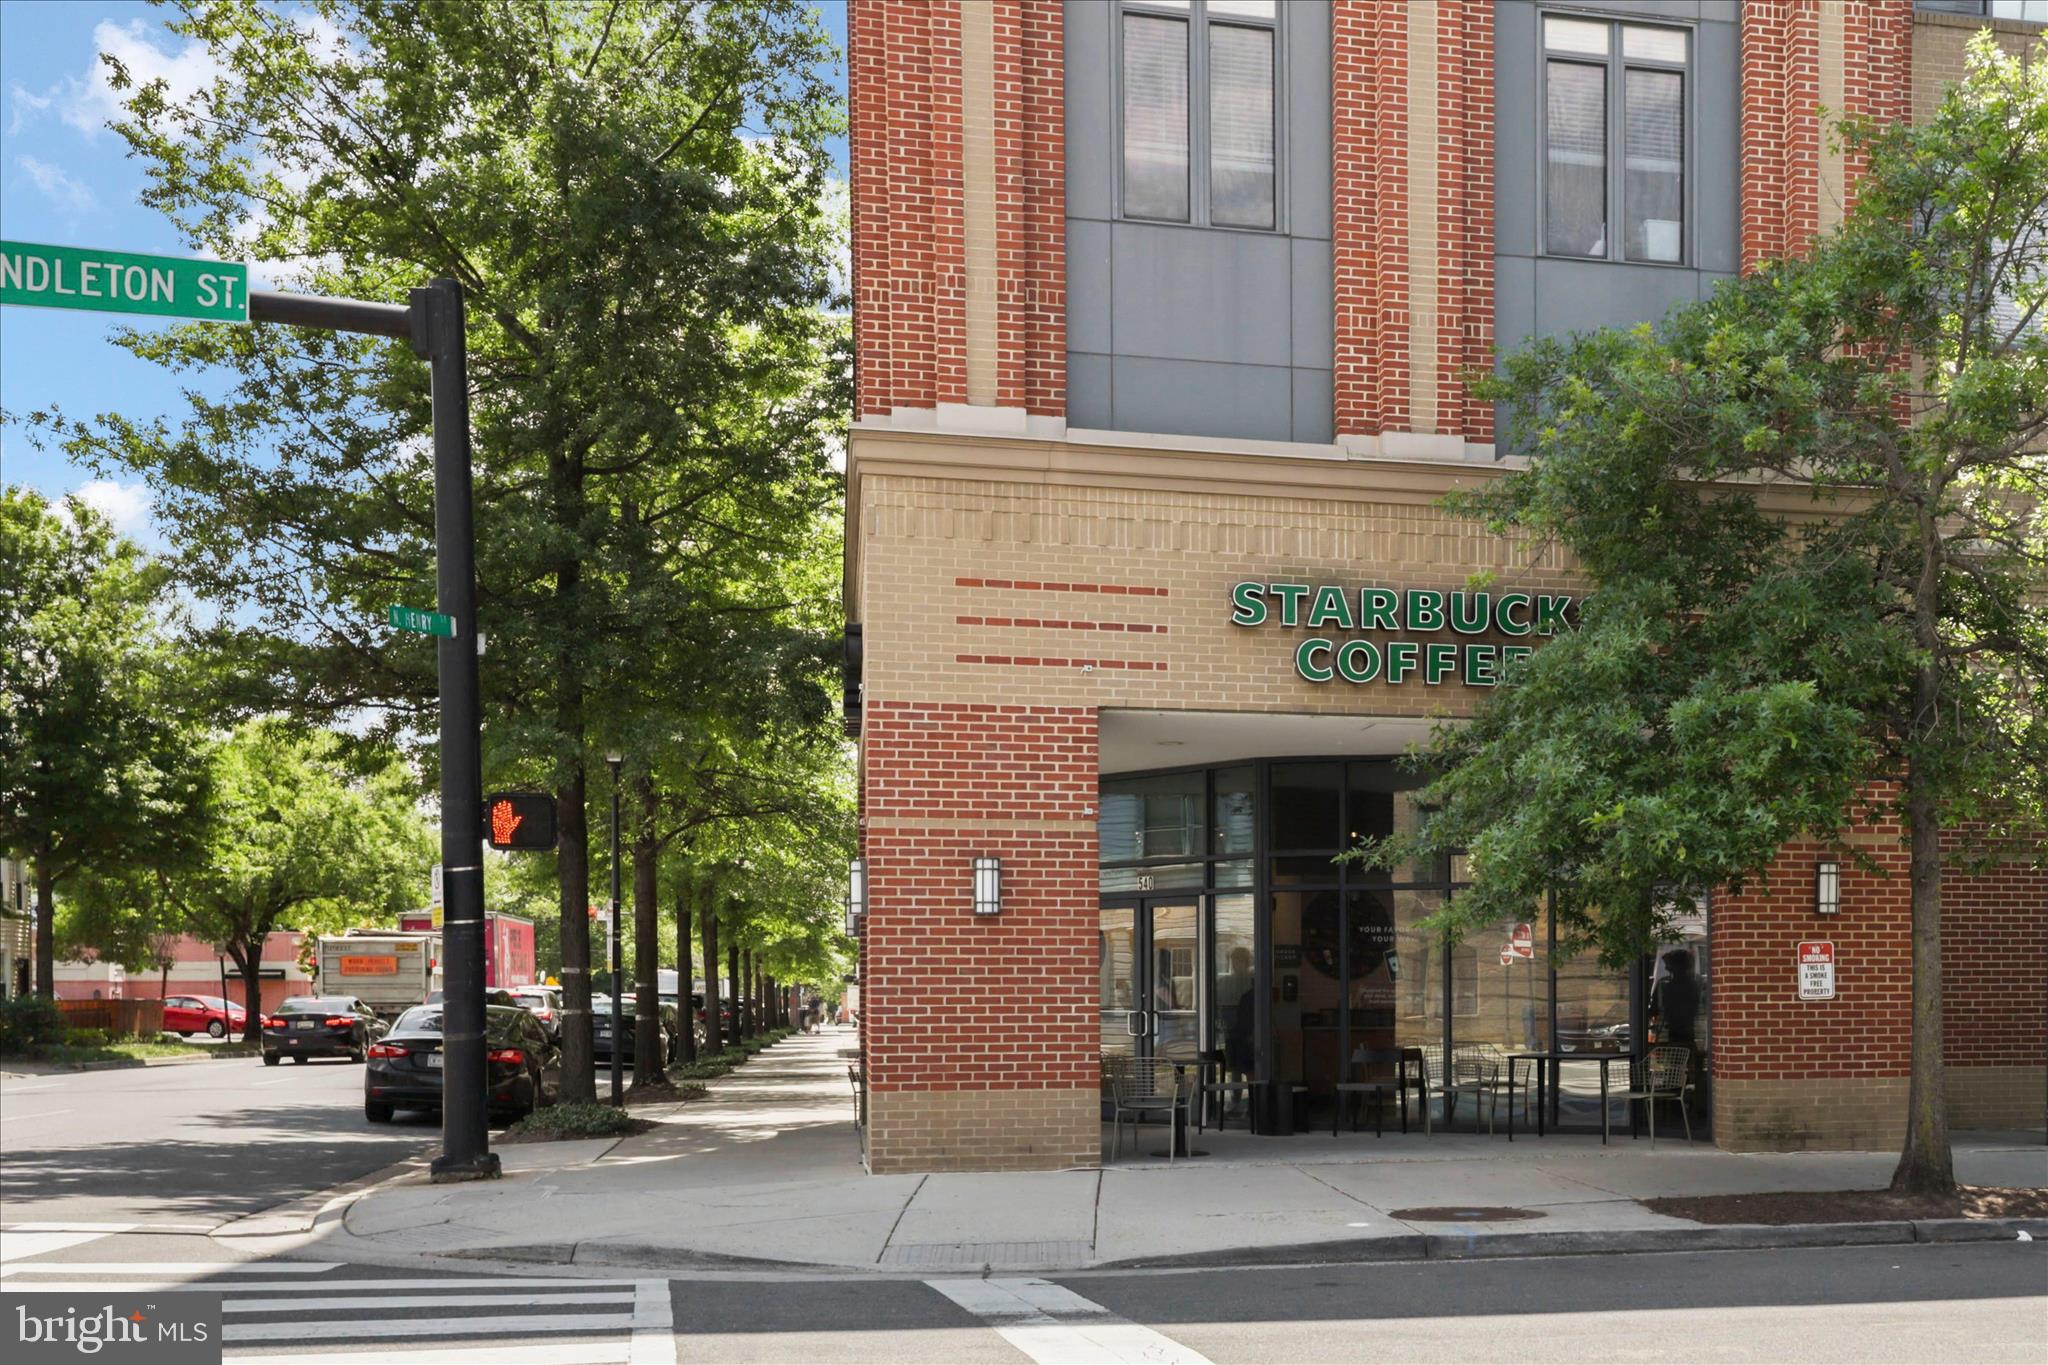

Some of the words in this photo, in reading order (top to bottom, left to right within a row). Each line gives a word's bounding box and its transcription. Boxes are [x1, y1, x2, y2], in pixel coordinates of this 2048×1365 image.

[197, 273, 246, 310] ST.
[1231, 581, 1585, 637] STARBUCK
[1138, 876, 1153, 890] 540
[1811, 946, 1821, 954] NO
